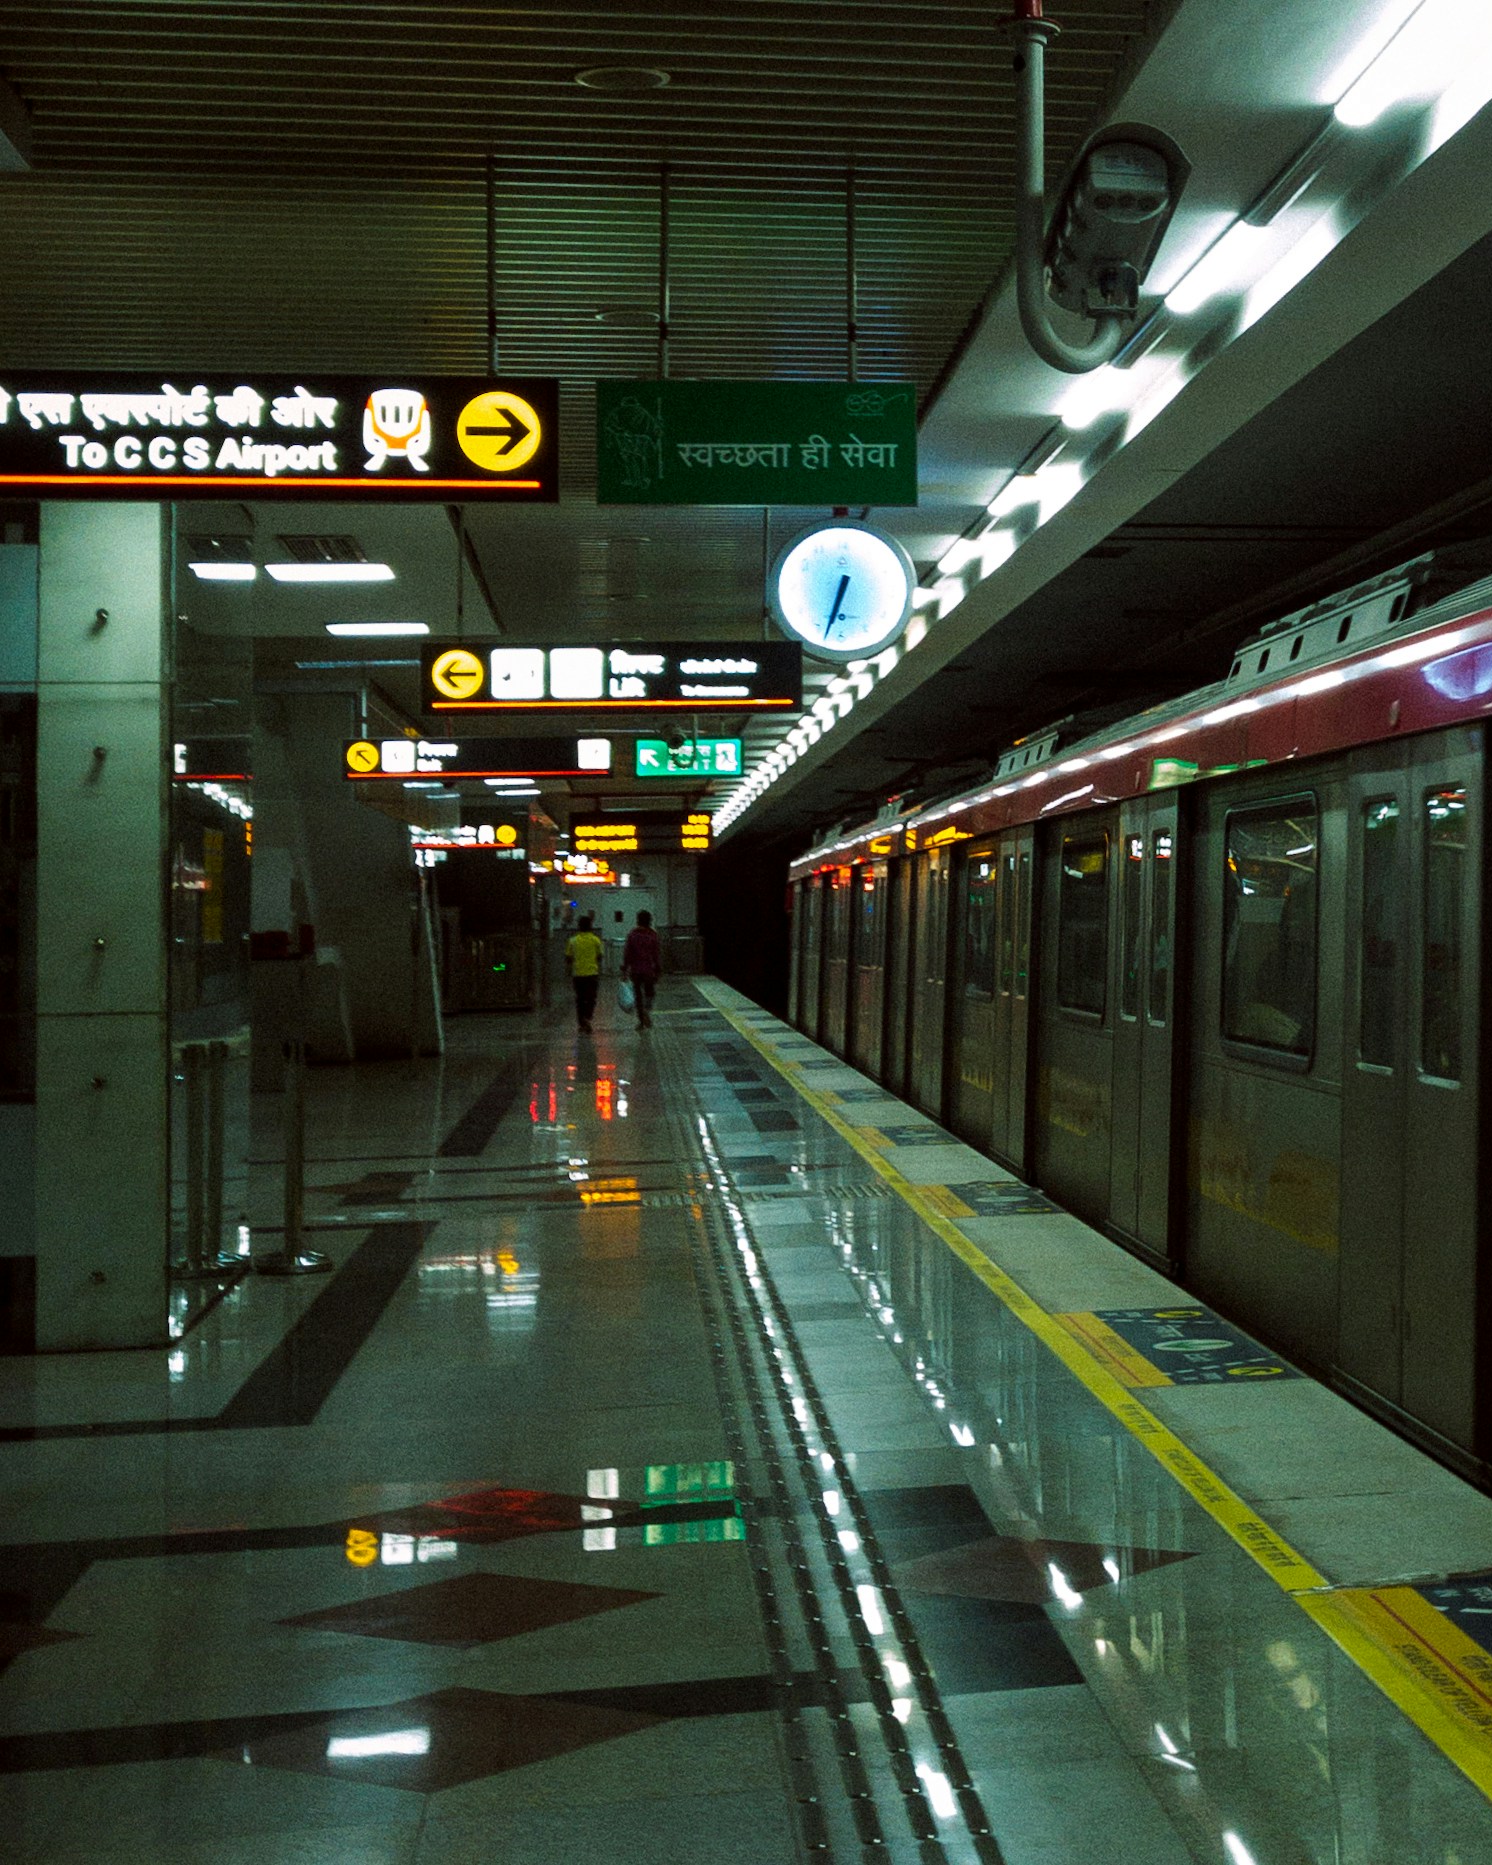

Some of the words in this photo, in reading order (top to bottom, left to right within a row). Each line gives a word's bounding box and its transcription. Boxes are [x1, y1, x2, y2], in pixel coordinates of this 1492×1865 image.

[213, 385, 266, 428] की
[270, 385, 338, 428] ओर
[59, 435, 107, 469] To
[214, 435, 337, 478] Airport
[676, 443, 791, 468] स्वच्छता
[799, 434, 831, 470] ही
[839, 433, 898, 468] सेवा
